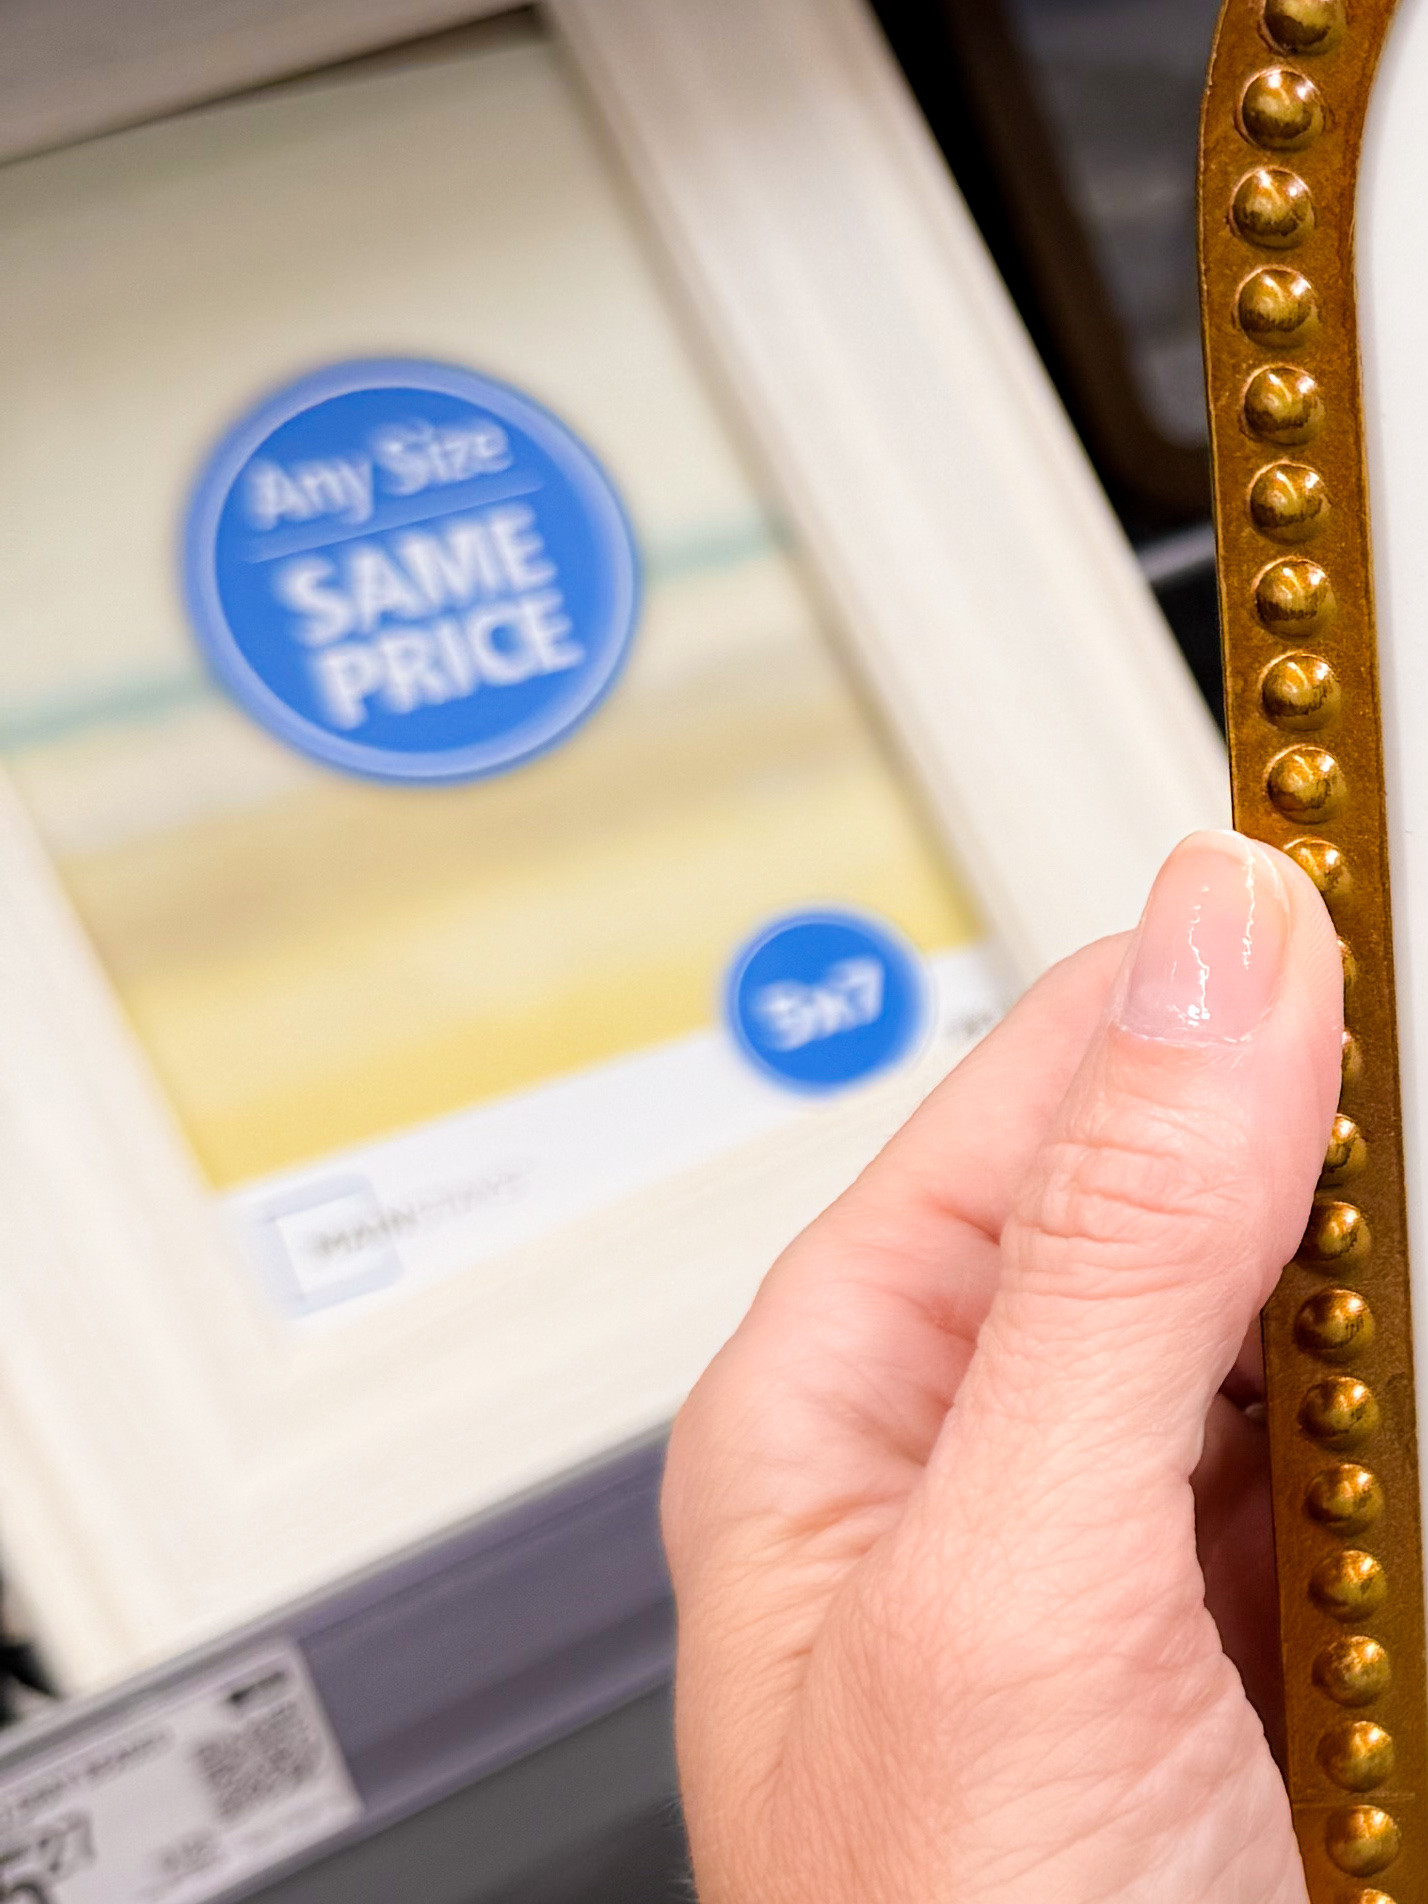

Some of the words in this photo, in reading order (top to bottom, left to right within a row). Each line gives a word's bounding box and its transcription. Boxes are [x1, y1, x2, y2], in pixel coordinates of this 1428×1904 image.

[251, 458, 372, 528] Any
[375, 419, 512, 495] Size
[278, 502, 556, 646] SAME
[315, 589, 584, 730] PRICE
[757, 962, 884, 1051] 5x7
